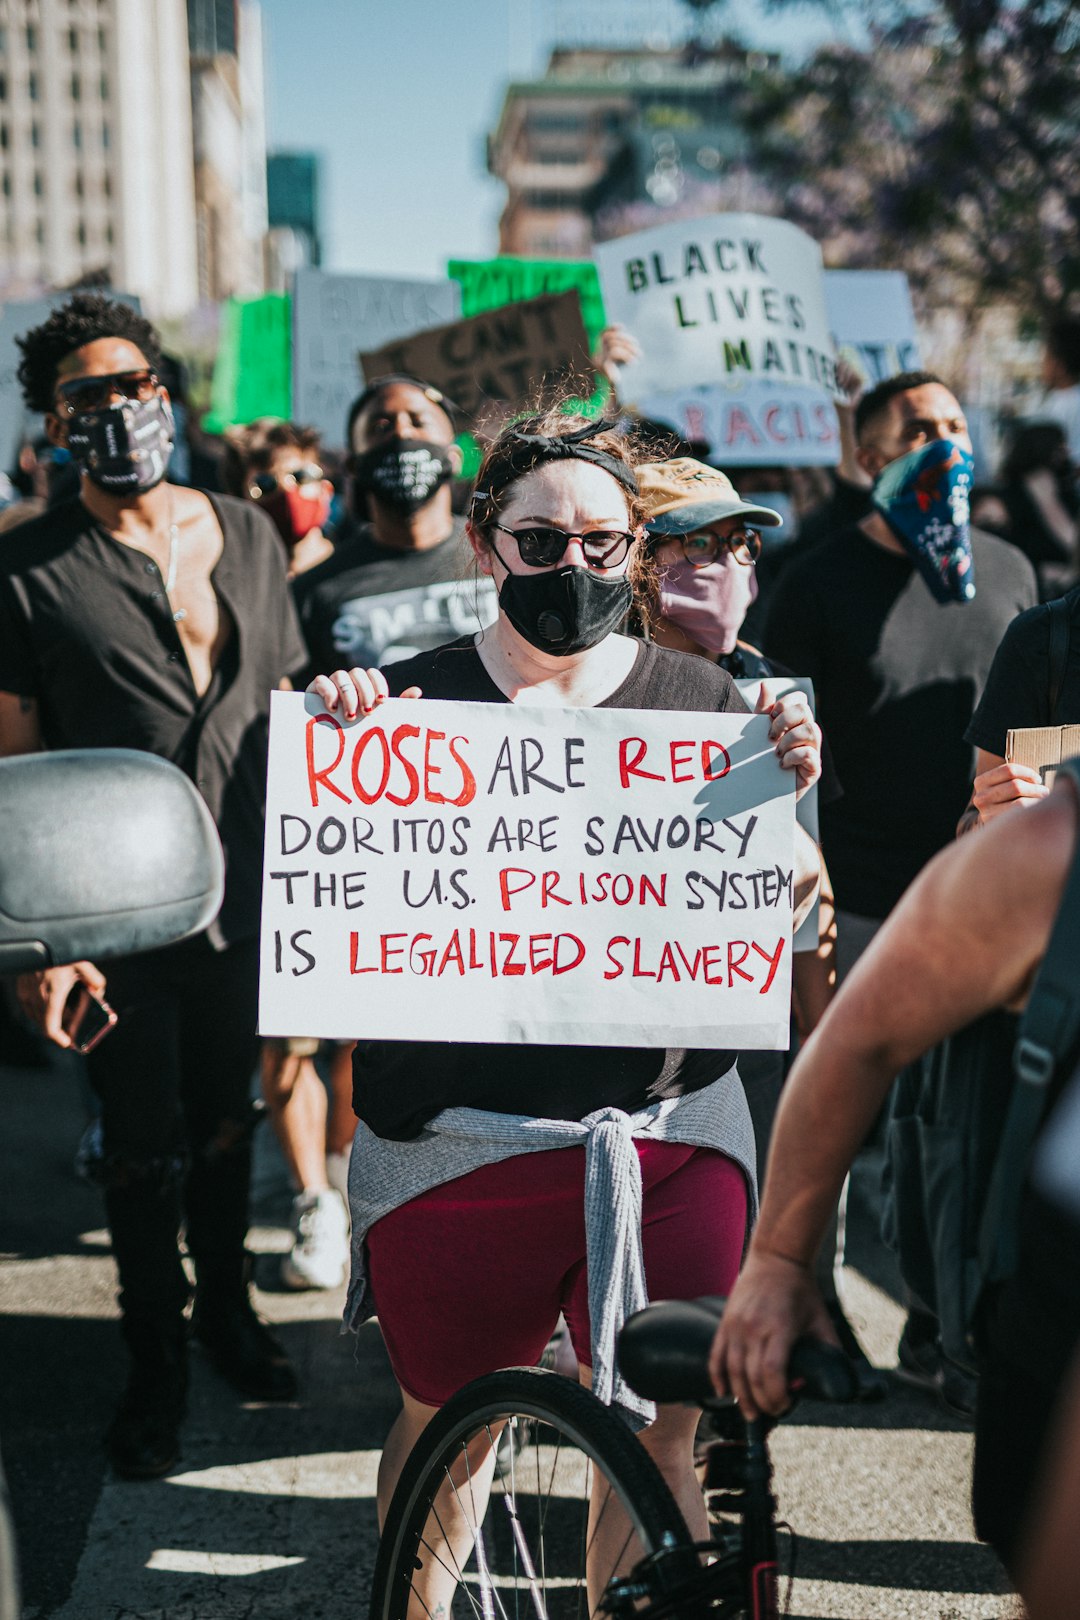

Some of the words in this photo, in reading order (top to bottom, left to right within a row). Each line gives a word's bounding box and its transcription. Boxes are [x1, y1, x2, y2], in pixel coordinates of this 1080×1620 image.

[626, 238, 767, 292] BLACK
[673, 288, 806, 329] LIVES
[305, 710, 475, 807] ROSES
[487, 736, 586, 797] ARE
[618, 737, 731, 789] RED
[280, 813, 471, 856] DORITOS
[487, 815, 560, 853] ARE
[584, 814, 758, 859] SAVORY
[270, 870, 367, 909] THE
[403, 869, 476, 910] U.S.
[499, 868, 667, 911] PRISON
[685, 864, 793, 912] SYSTEM
[274, 929, 316, 977] IS
[349, 927, 586, 978] LEGALIZED
[603, 936, 785, 994] SLAVERY
